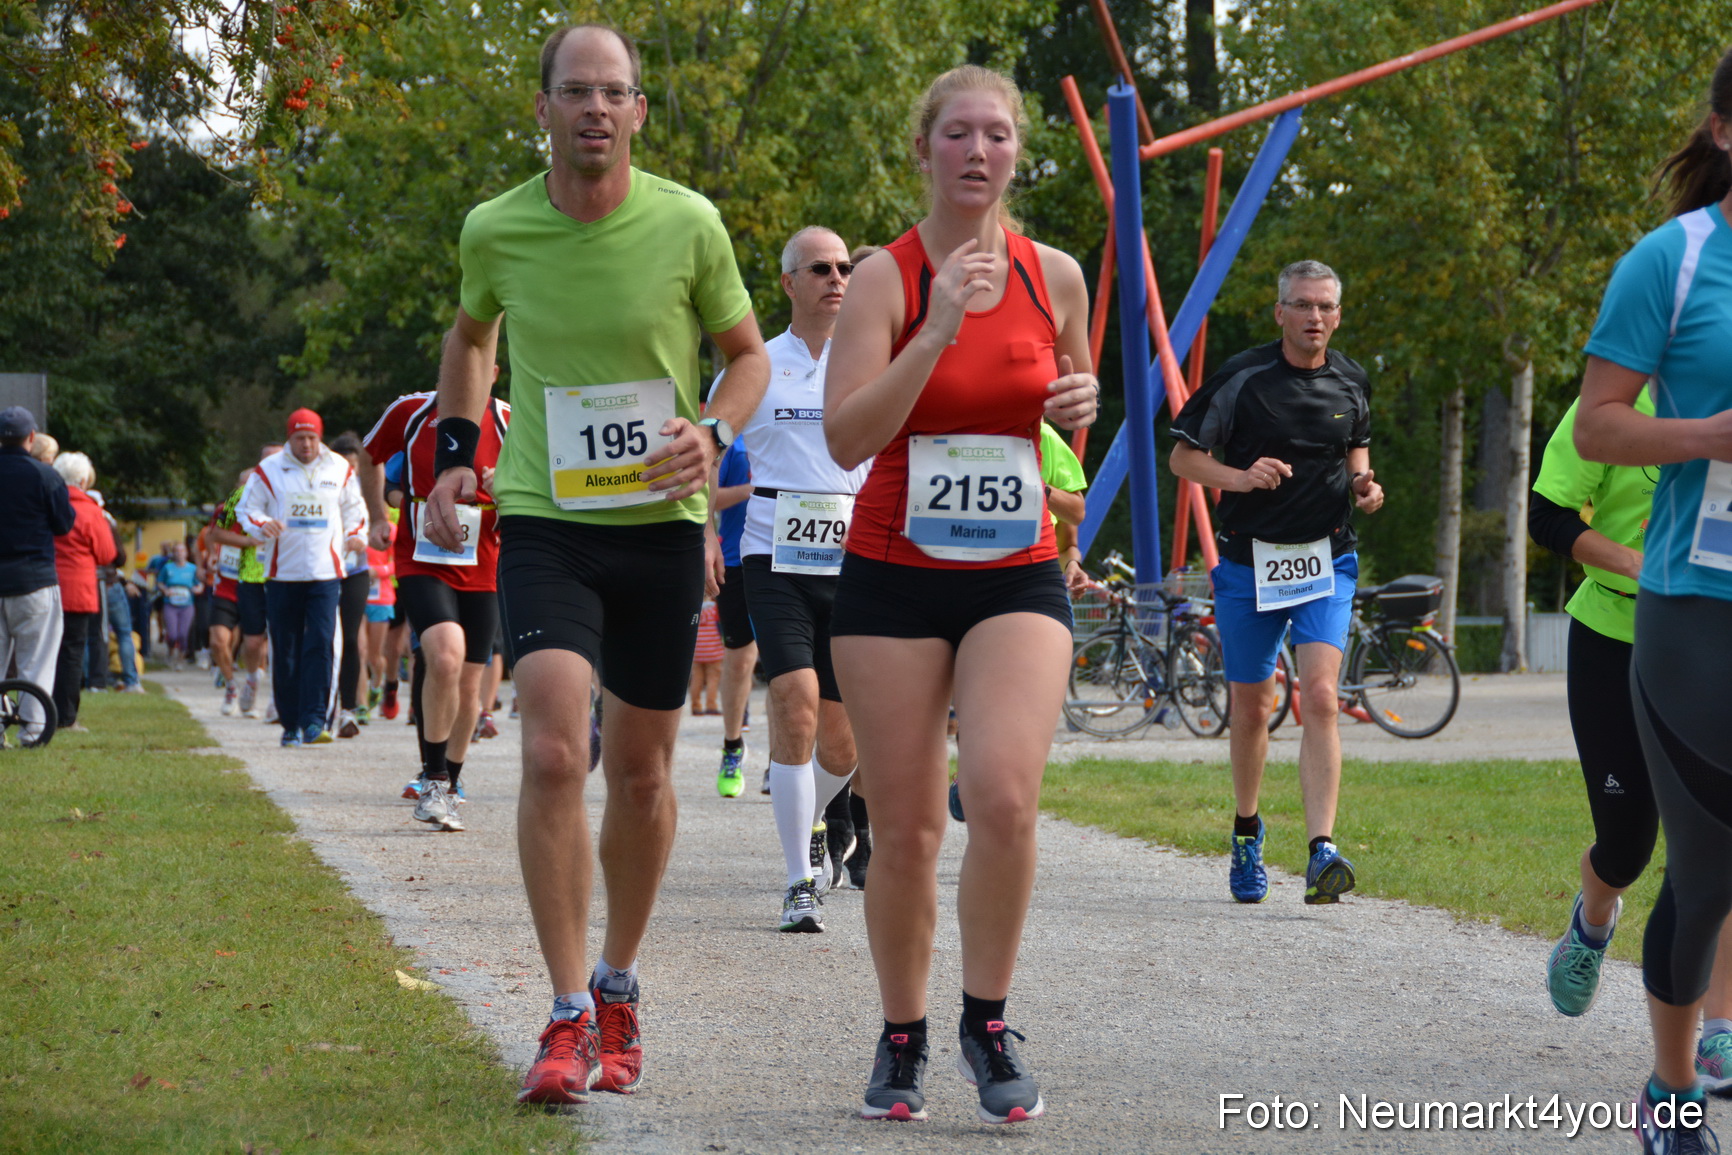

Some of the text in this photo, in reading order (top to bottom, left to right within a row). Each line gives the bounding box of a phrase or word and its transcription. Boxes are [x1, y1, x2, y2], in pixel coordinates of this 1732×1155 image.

[594, 393, 638, 408] BOCK
[579, 420, 648, 461] 195
[961, 447, 1005, 458] BOCK
[585, 470, 643, 487] Alexande
[928, 474, 1023, 512] 2153
[291, 504, 323, 517] 2244
[786, 517, 846, 544] 2479
[950, 524, 996, 539] Marina
[797, 550, 834, 561] Matthias
[1266, 556, 1321, 582] 2390
[1278, 584, 1313, 597] Reinhard
